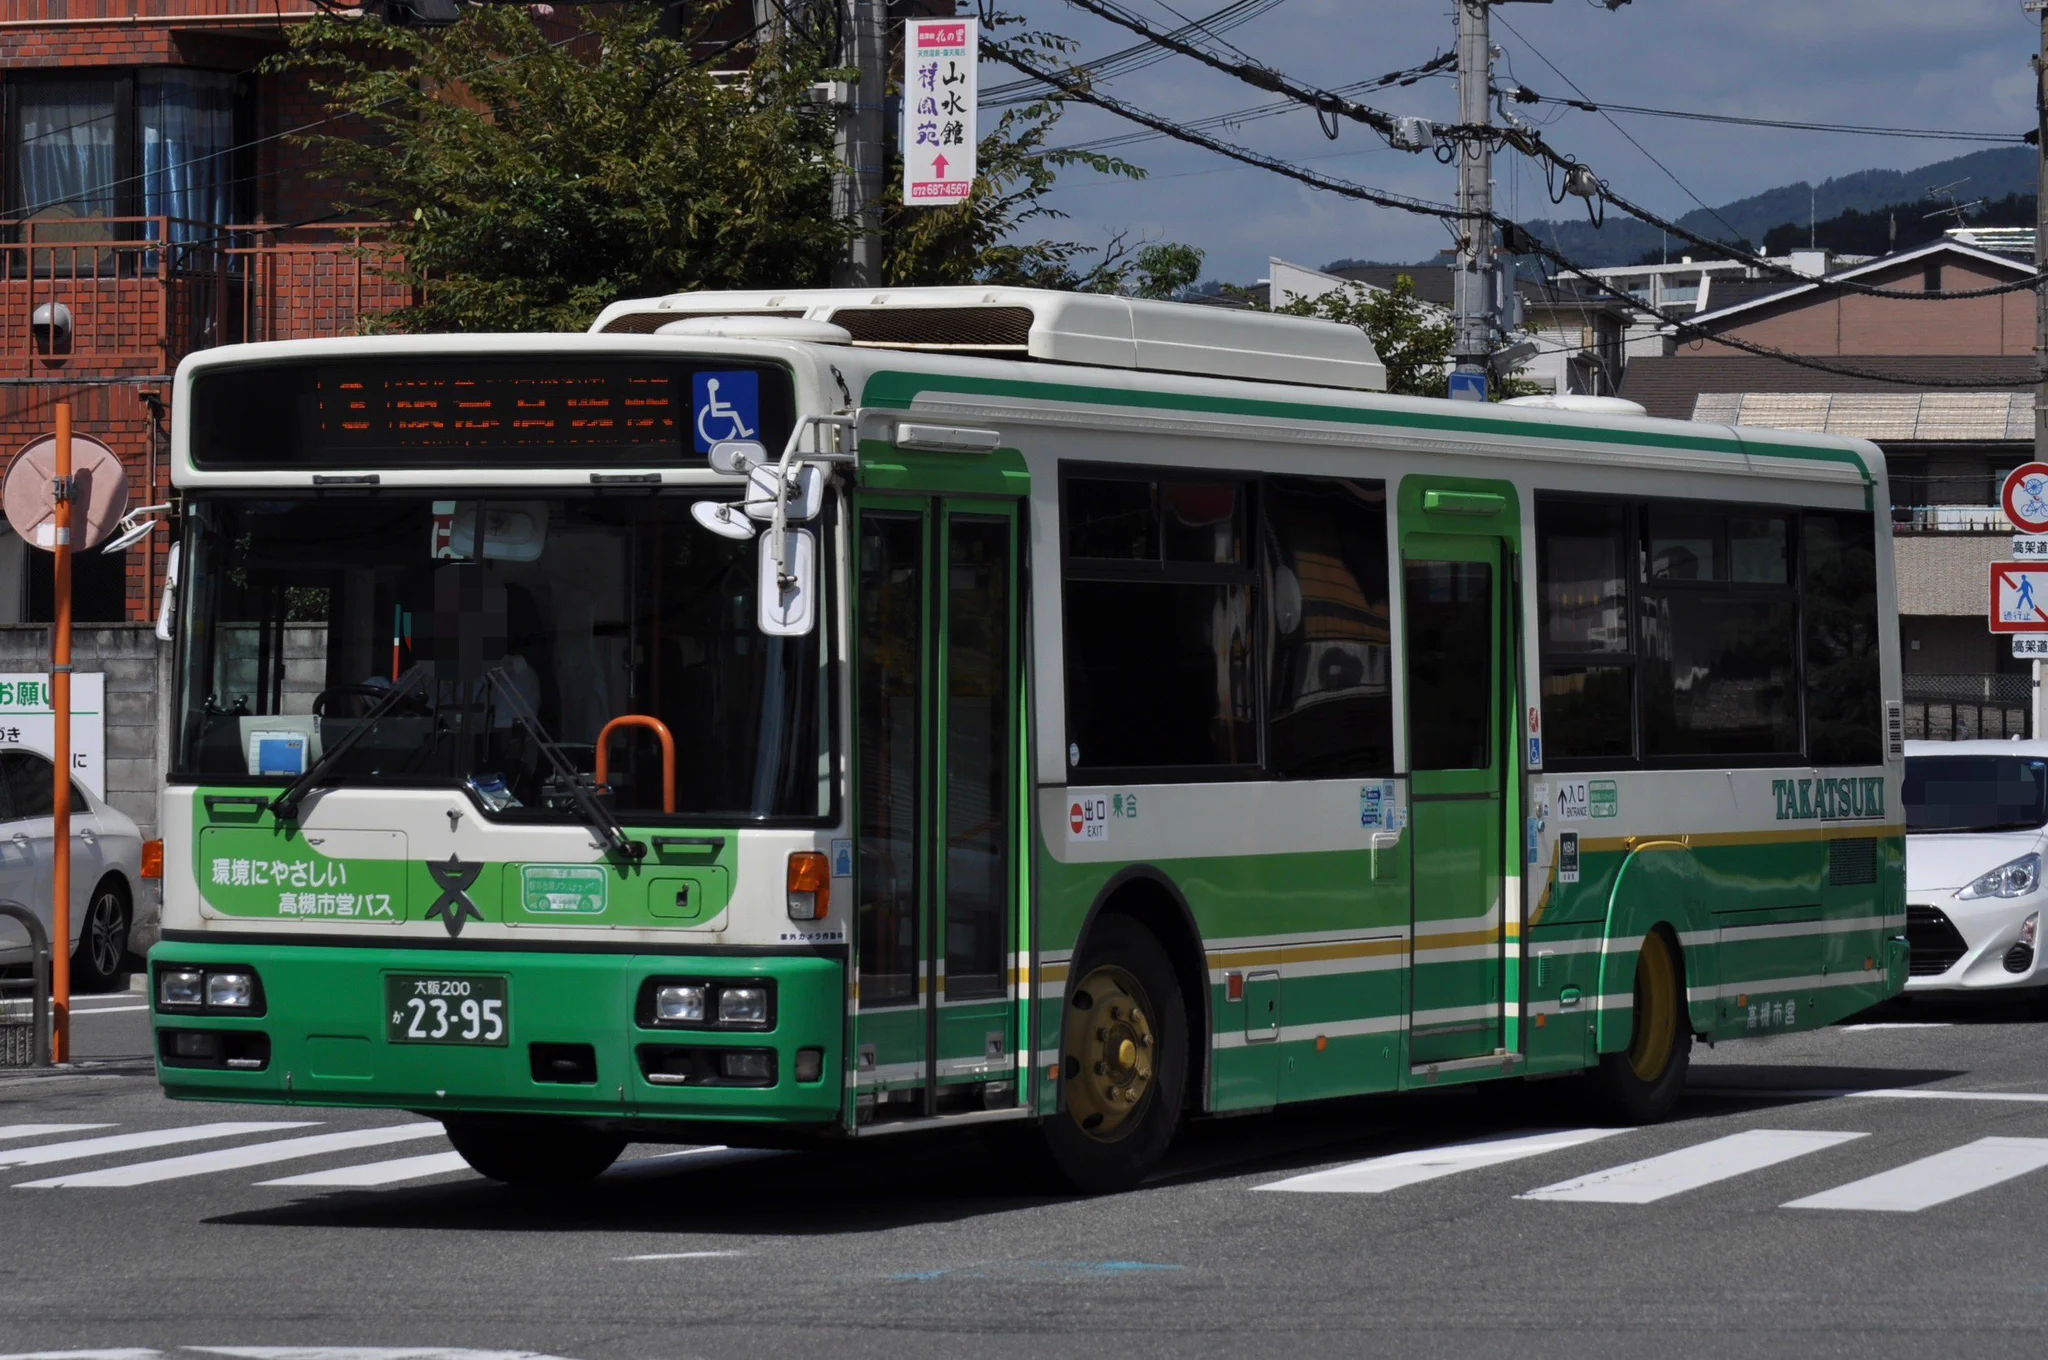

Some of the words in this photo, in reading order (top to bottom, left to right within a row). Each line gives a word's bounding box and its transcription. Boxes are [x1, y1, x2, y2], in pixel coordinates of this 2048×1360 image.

[936, 29, 964, 43] 花の里
[941, 61, 966, 146] 山水館
[913, 186, 926, 196] 072
[1112, 793, 1137, 818] 乗合
[1568, 785, 1585, 803] 入口
[1772, 777, 1885, 820] TAKATSUKI
[1085, 800, 1105, 821] 出口
[1566, 806, 1587, 817] ENTRANCE
[1087, 825, 1103, 837] EXIT
[212, 858, 347, 887] 環境にやさしい
[278, 892, 394, 917] 高槻市営バス
[392, 1010, 404, 1025] か
[407, 998, 503, 1040] 23-95
